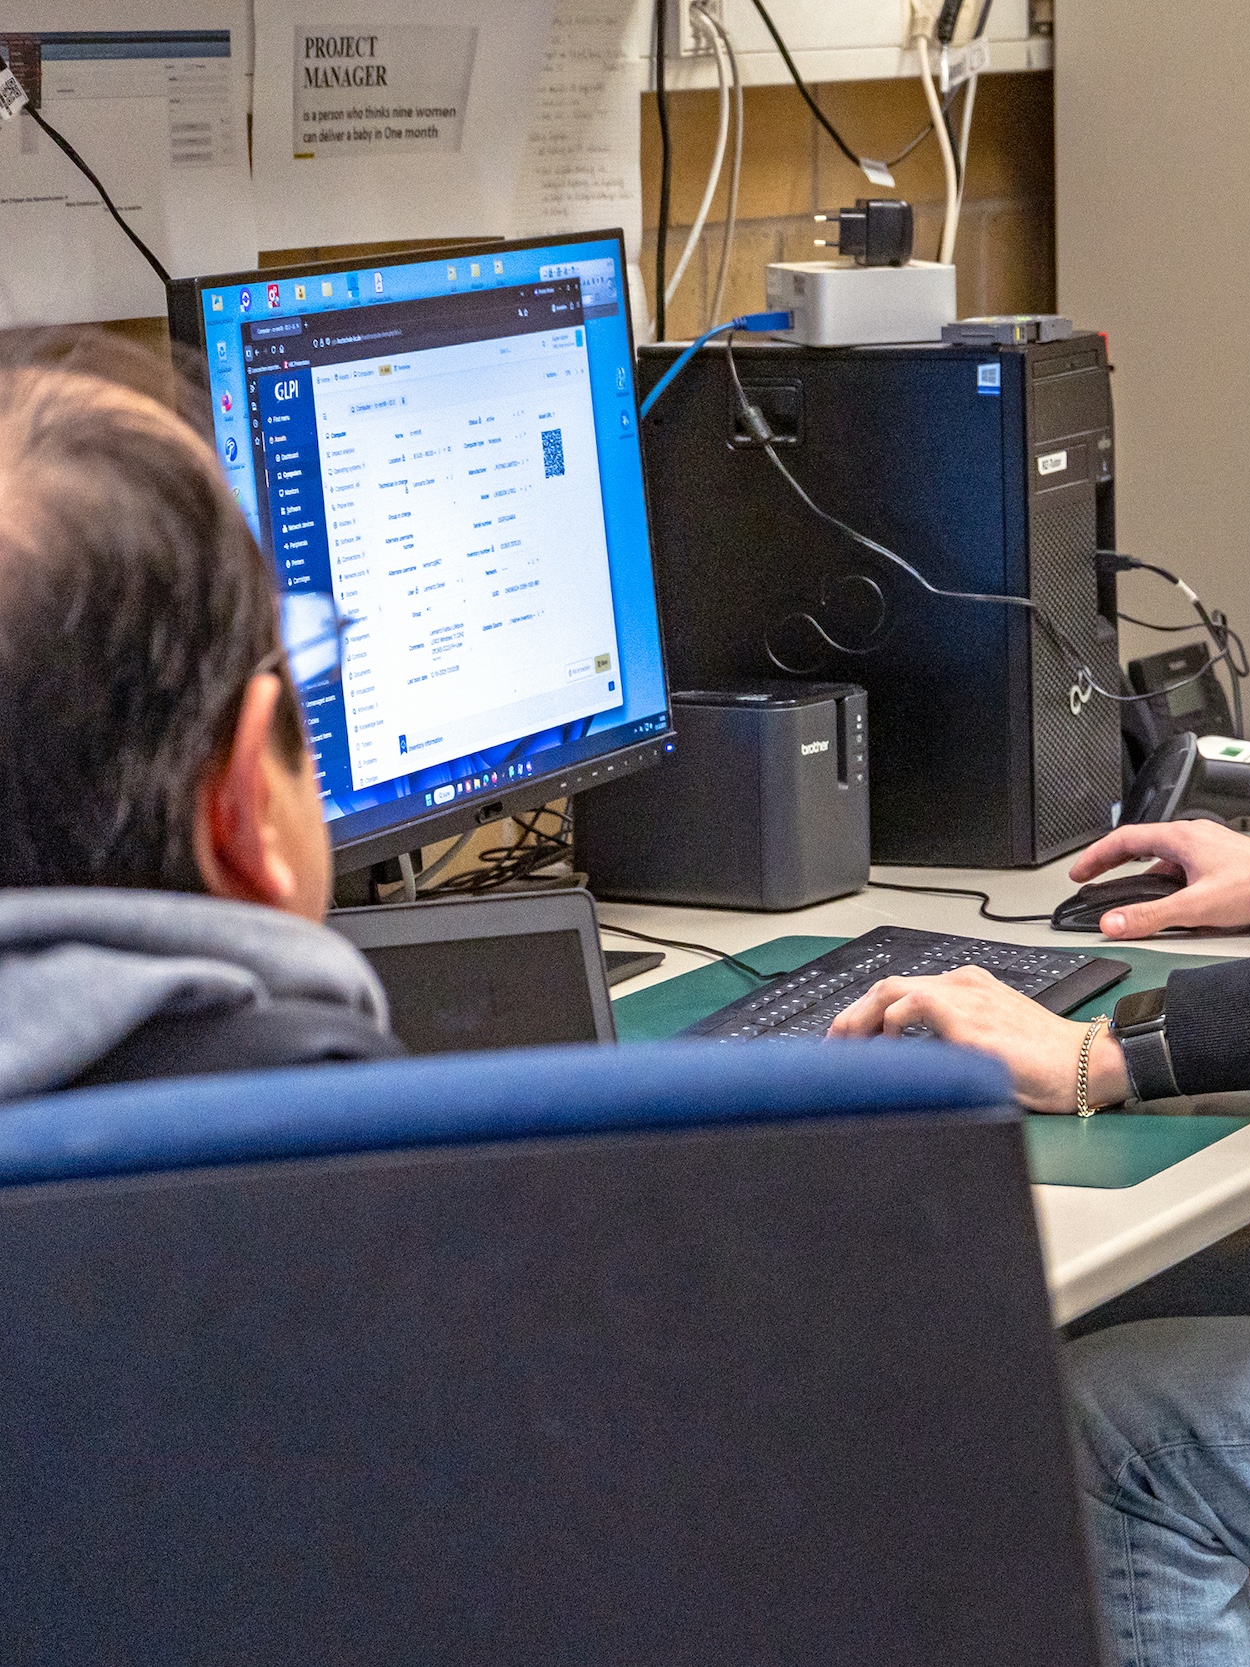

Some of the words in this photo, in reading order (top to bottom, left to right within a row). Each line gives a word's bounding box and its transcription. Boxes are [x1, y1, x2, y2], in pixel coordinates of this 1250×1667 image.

[305, 36, 378, 59] PROJECT
[304, 65, 388, 89] MANAGER
[303, 111, 310, 121] is
[318, 110, 345, 123] person
[347, 107, 363, 119] who
[365, 105, 390, 119] thinks
[392, 107, 413, 118] nine
[415, 106, 456, 118] women
[303, 132, 318, 143] can
[319, 129, 345, 142] deliver
[353, 127, 373, 144] baby
[374, 128, 383, 139] in
[384, 126, 403, 139] One
[405, 125, 438, 138] month
[274, 380, 299, 402] GLPI
[801, 740, 829, 756] brother
